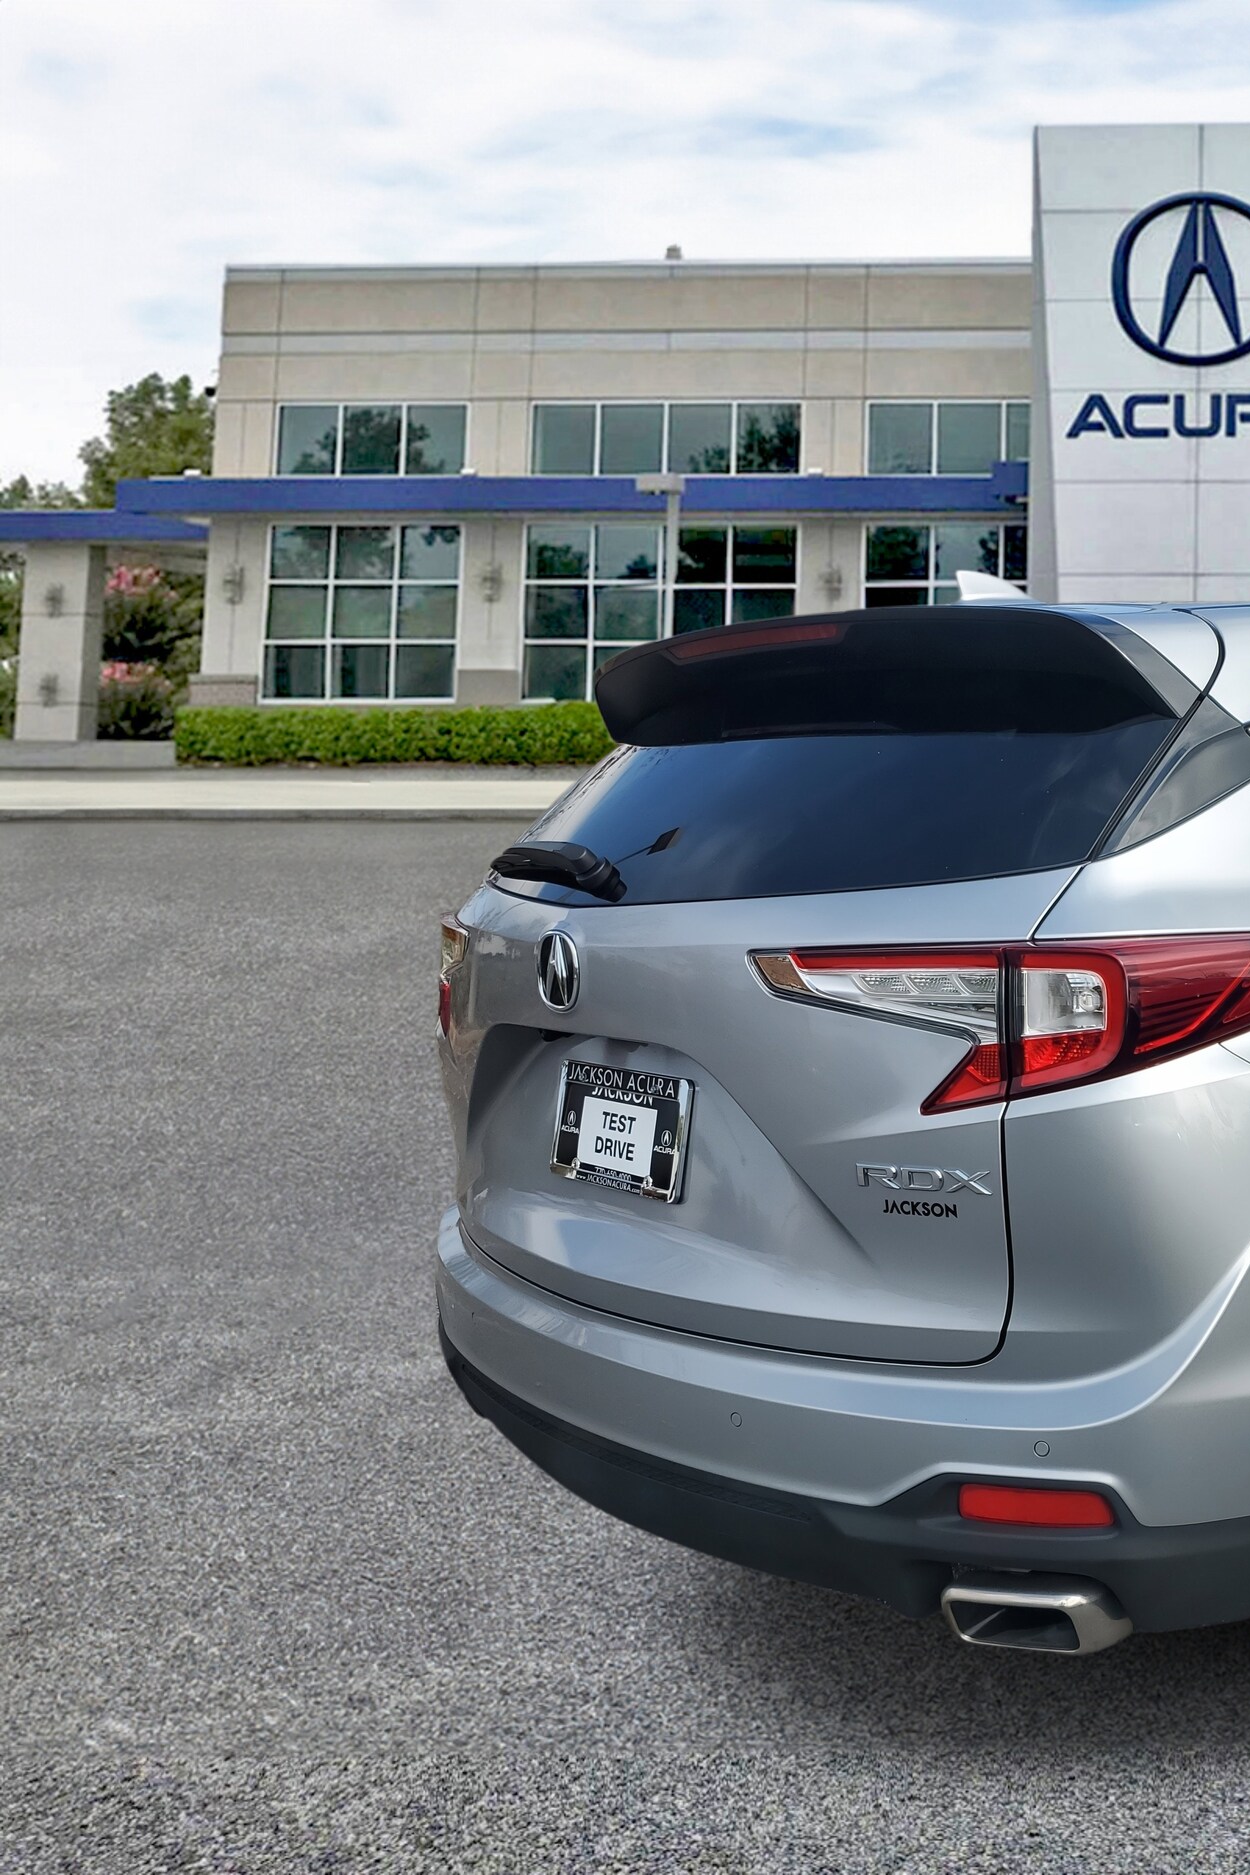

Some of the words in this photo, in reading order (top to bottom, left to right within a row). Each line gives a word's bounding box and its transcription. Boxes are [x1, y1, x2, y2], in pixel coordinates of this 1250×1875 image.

[568, 1063, 623, 1088] JACKSON
[626, 1074, 675, 1098] ACURA
[561, 1124, 580, 1134] ACURA
[602, 1111, 636, 1134] TEST
[595, 1136, 635, 1161] DRIVE
[654, 1145, 678, 1155] ACURA
[855, 1162, 993, 1196] RDX
[883, 1199, 958, 1218] JACKSON
